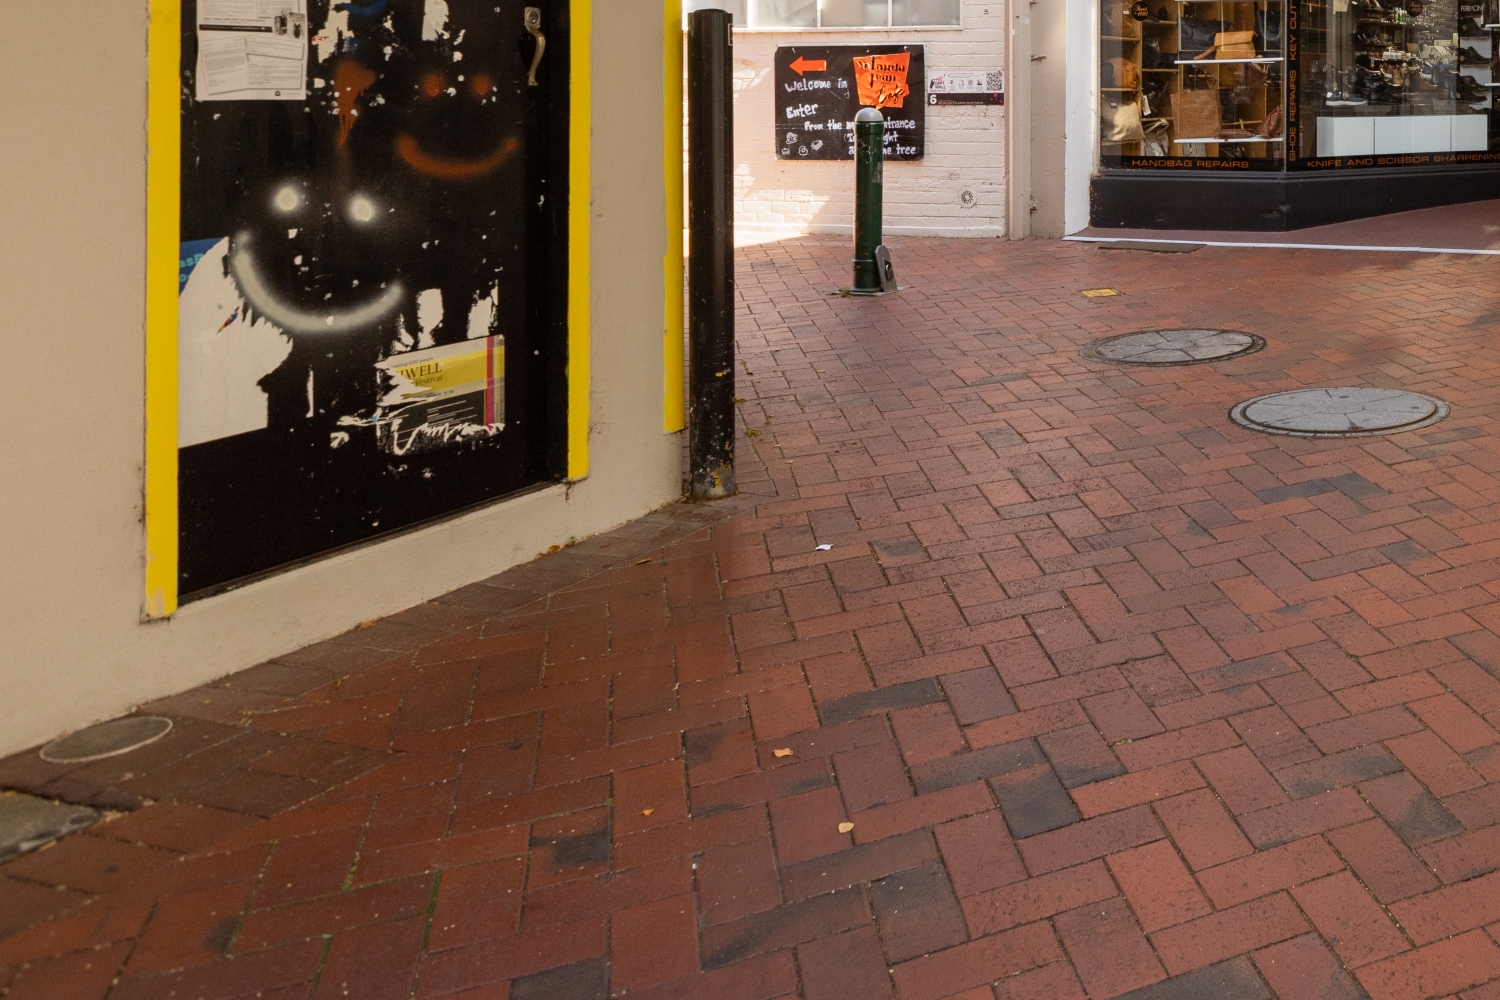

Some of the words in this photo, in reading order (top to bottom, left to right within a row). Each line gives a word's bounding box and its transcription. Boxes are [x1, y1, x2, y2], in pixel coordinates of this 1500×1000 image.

[1289, 34, 1297, 61] KEY
[858, 56, 906, 72] Yolanda
[784, 77, 832, 93] Welcome
[837, 77, 848, 89] in
[929, 94, 938, 105] 6
[1289, 70, 1297, 122] REPAIRS
[785, 103, 819, 119] Enter
[827, 118, 843, 131] the
[883, 116, 916, 129] ntrance
[1289, 134, 1297, 162] SHOE
[1131, 159, 1192, 168] HANDBAG
[1196, 160, 1250, 169] REPAIRS
[1306, 159, 1343, 168] KNIFE
[1346, 157, 1374, 167] AND
[1377, 155, 1430, 165] SCISSOR
